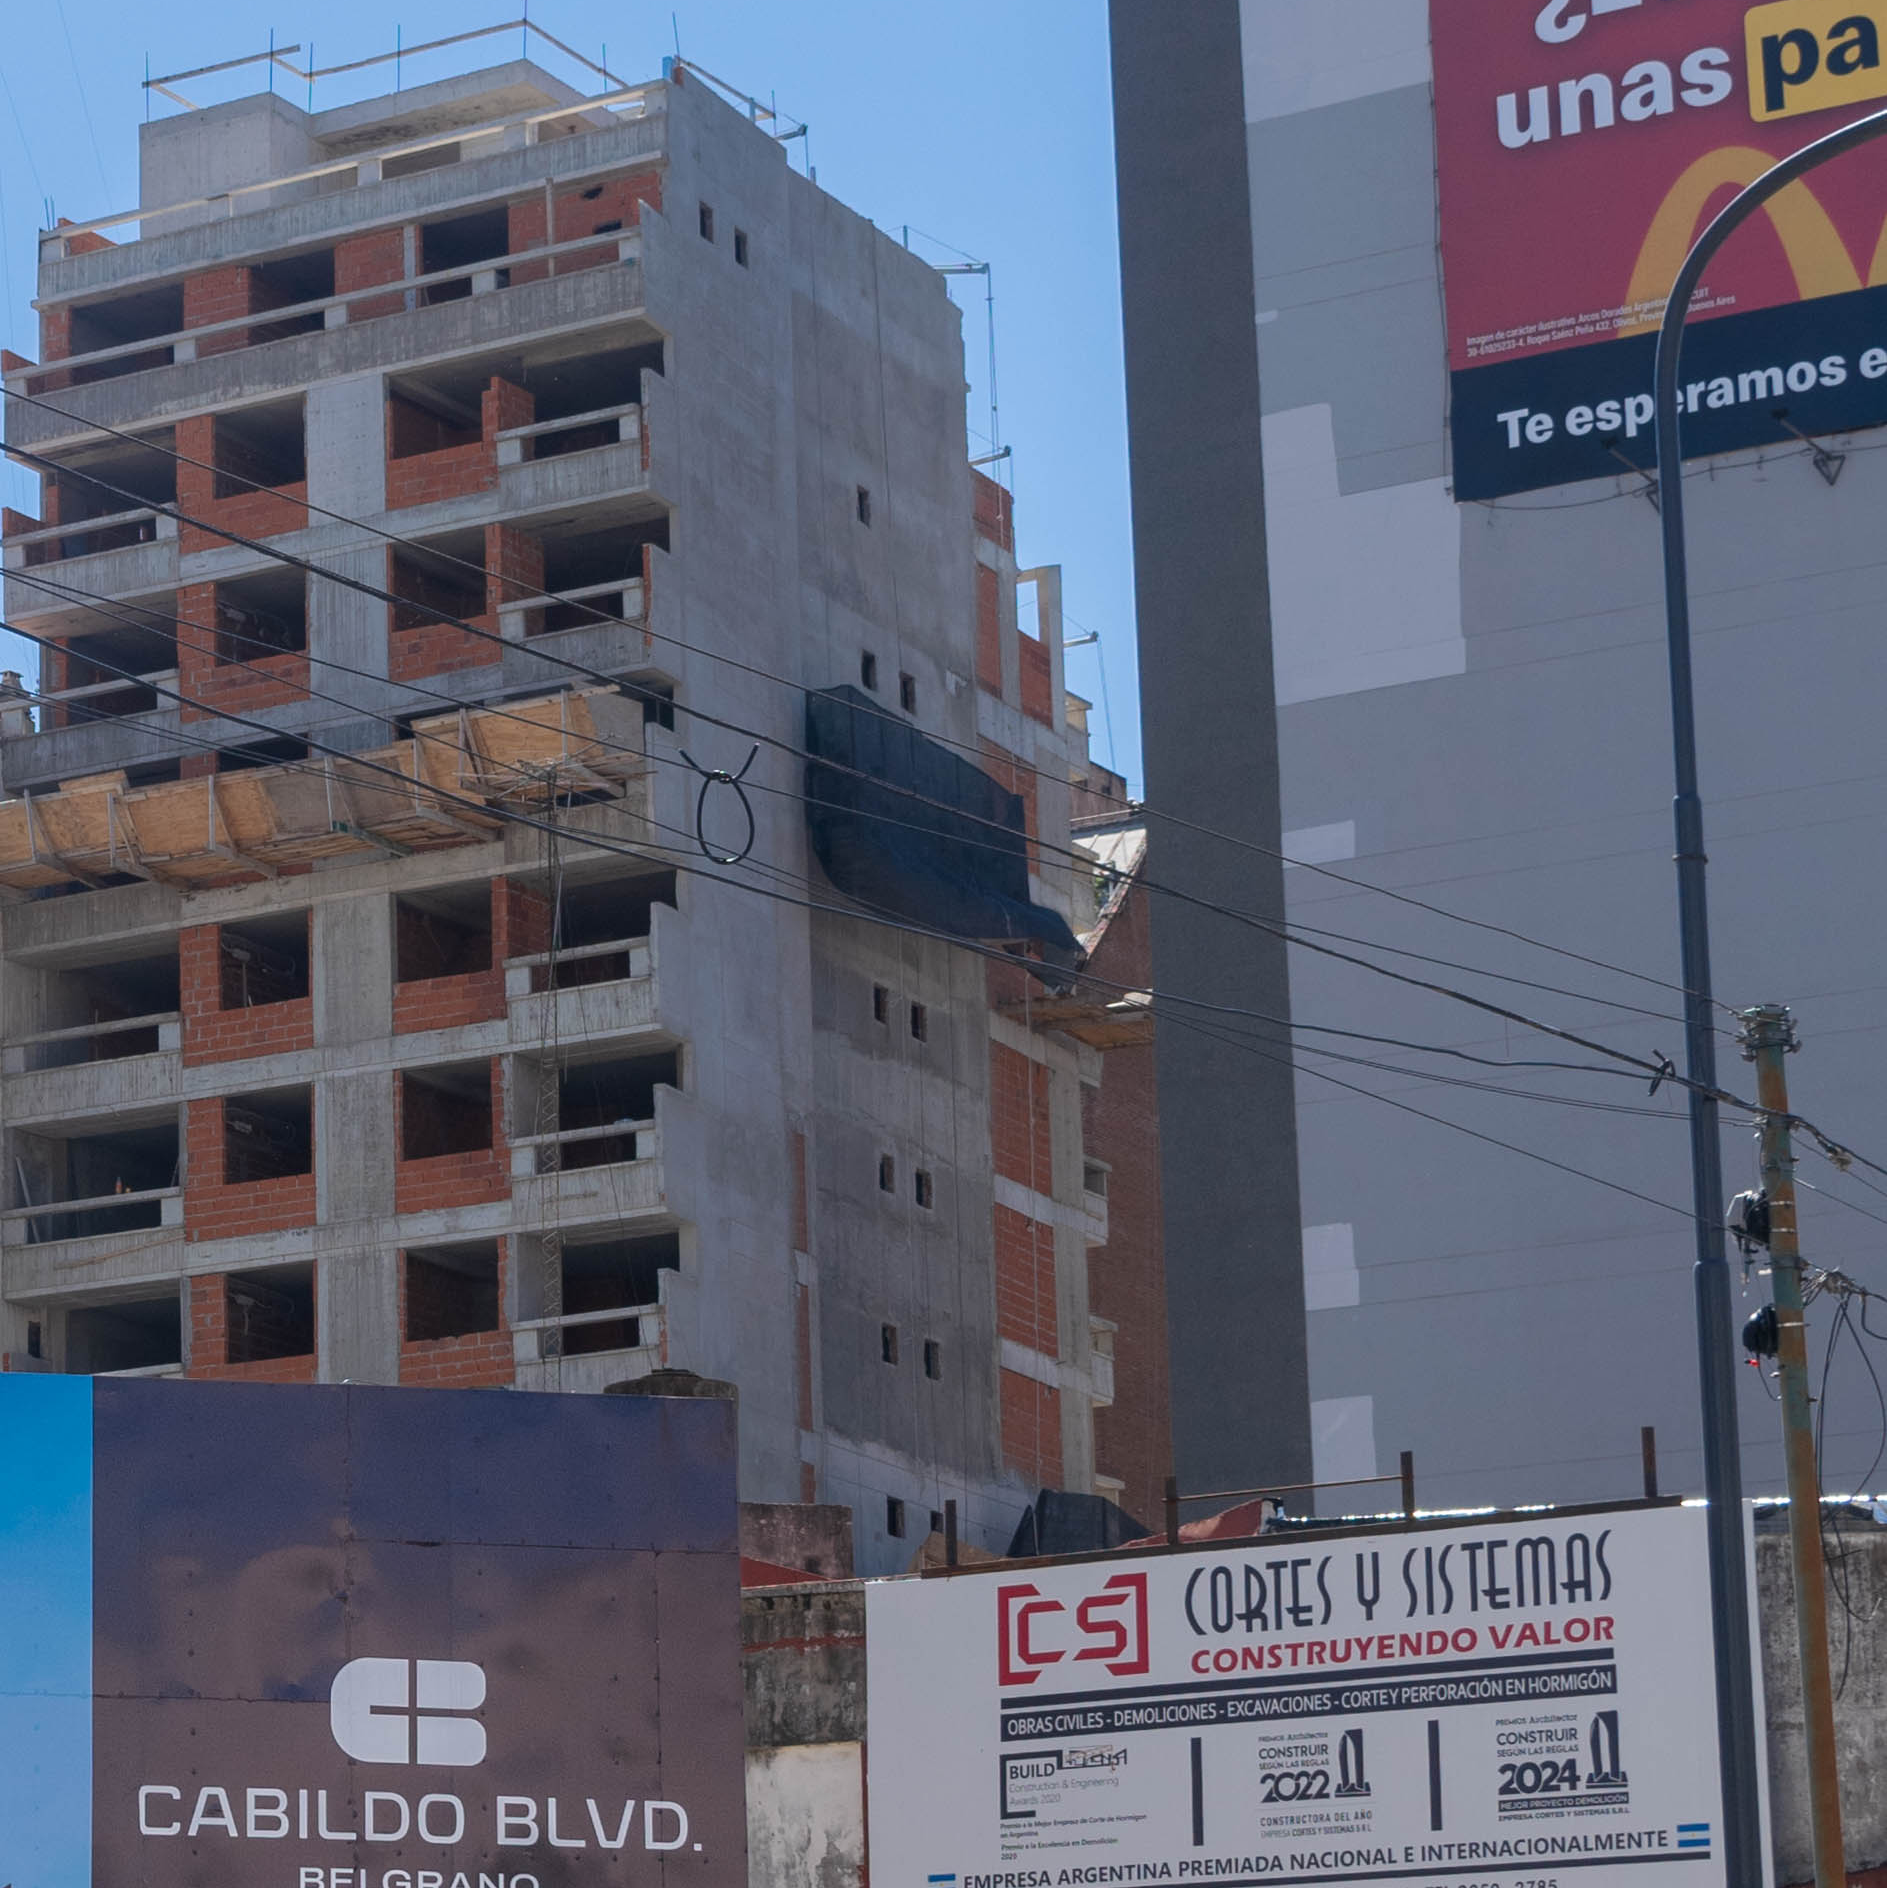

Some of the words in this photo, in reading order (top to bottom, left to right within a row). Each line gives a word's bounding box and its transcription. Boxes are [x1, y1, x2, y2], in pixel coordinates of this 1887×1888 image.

[1496, 47, 1733, 149] unas
[1497, 409, 1553, 449] Te
[1184, 1555, 1333, 1636] CORTES
[1356, 1551, 1380, 1621] Y
[1402, 1529, 1612, 1618] SISTEMAS
[1191, 1627, 1478, 1674] CONSTRUYENDO
[1488, 1616, 1614, 1650] VALOR
[1008, 1716, 1052, 1736] OBRAS
[1055, 1712, 1104, 1731] CIVILES
[1114, 1703, 1216, 1727] DEMOLICIONES
[1228, 1694, 1331, 1717] EXCAVACIONES
[1401, 1678, 1501, 1704] PERFORACIÓN
[1506, 1678, 1525, 1695] EN
[1528, 1669, 1612, 1694] HORMIGÓN
[1258, 1744, 1329, 1760] CONSTRUIR
[1496, 1728, 1578, 1746] CONSTRUIR
[1010, 1763, 1055, 1780] BUILD
[1260, 1769, 1330, 1803] 2022
[1498, 1758, 1581, 1795] 2024
[137, 1784, 466, 1845] CABILDO
[496, 1796, 703, 1851] BLVD.
[1260, 1813, 1331, 1827] CONSTRUCTORA
[1334, 1812, 1350, 1822] DEL
[1057, 1861, 1172, 1887] ARGENTINA
[1178, 1855, 1284, 1879] PREMIADA
[1291, 1848, 1398, 1871] NACIONAL
[1404, 1846, 1414, 1863] E
[1420, 1830, 1668, 1862] INTERNACIONALMENTE
